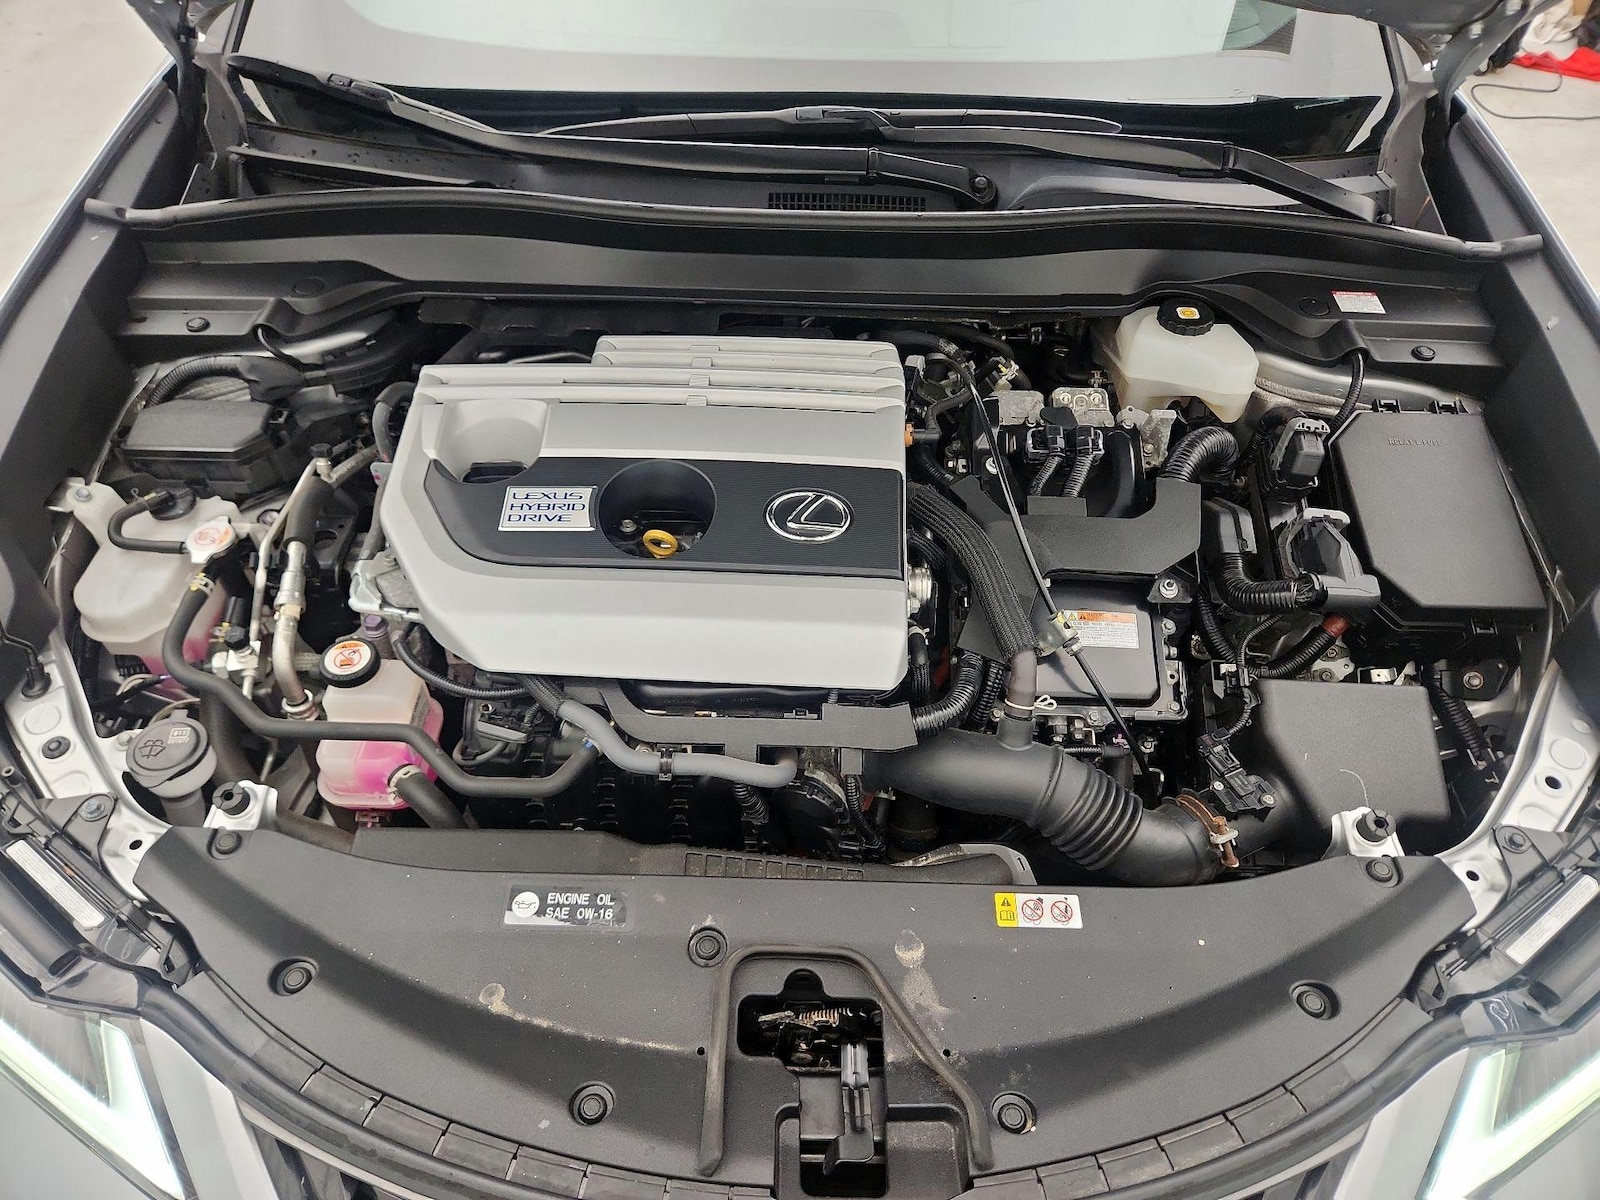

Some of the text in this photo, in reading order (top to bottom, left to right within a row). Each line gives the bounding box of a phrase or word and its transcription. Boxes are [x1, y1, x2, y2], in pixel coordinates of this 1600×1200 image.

[513, 492, 583, 500] LEXUS
[510, 503, 586, 511] HYBRID
[508, 514, 572, 522] DRIVE
[546, 892, 615, 906] ENGINE OIL
[545, 907, 613, 920] SAE 0W-16
